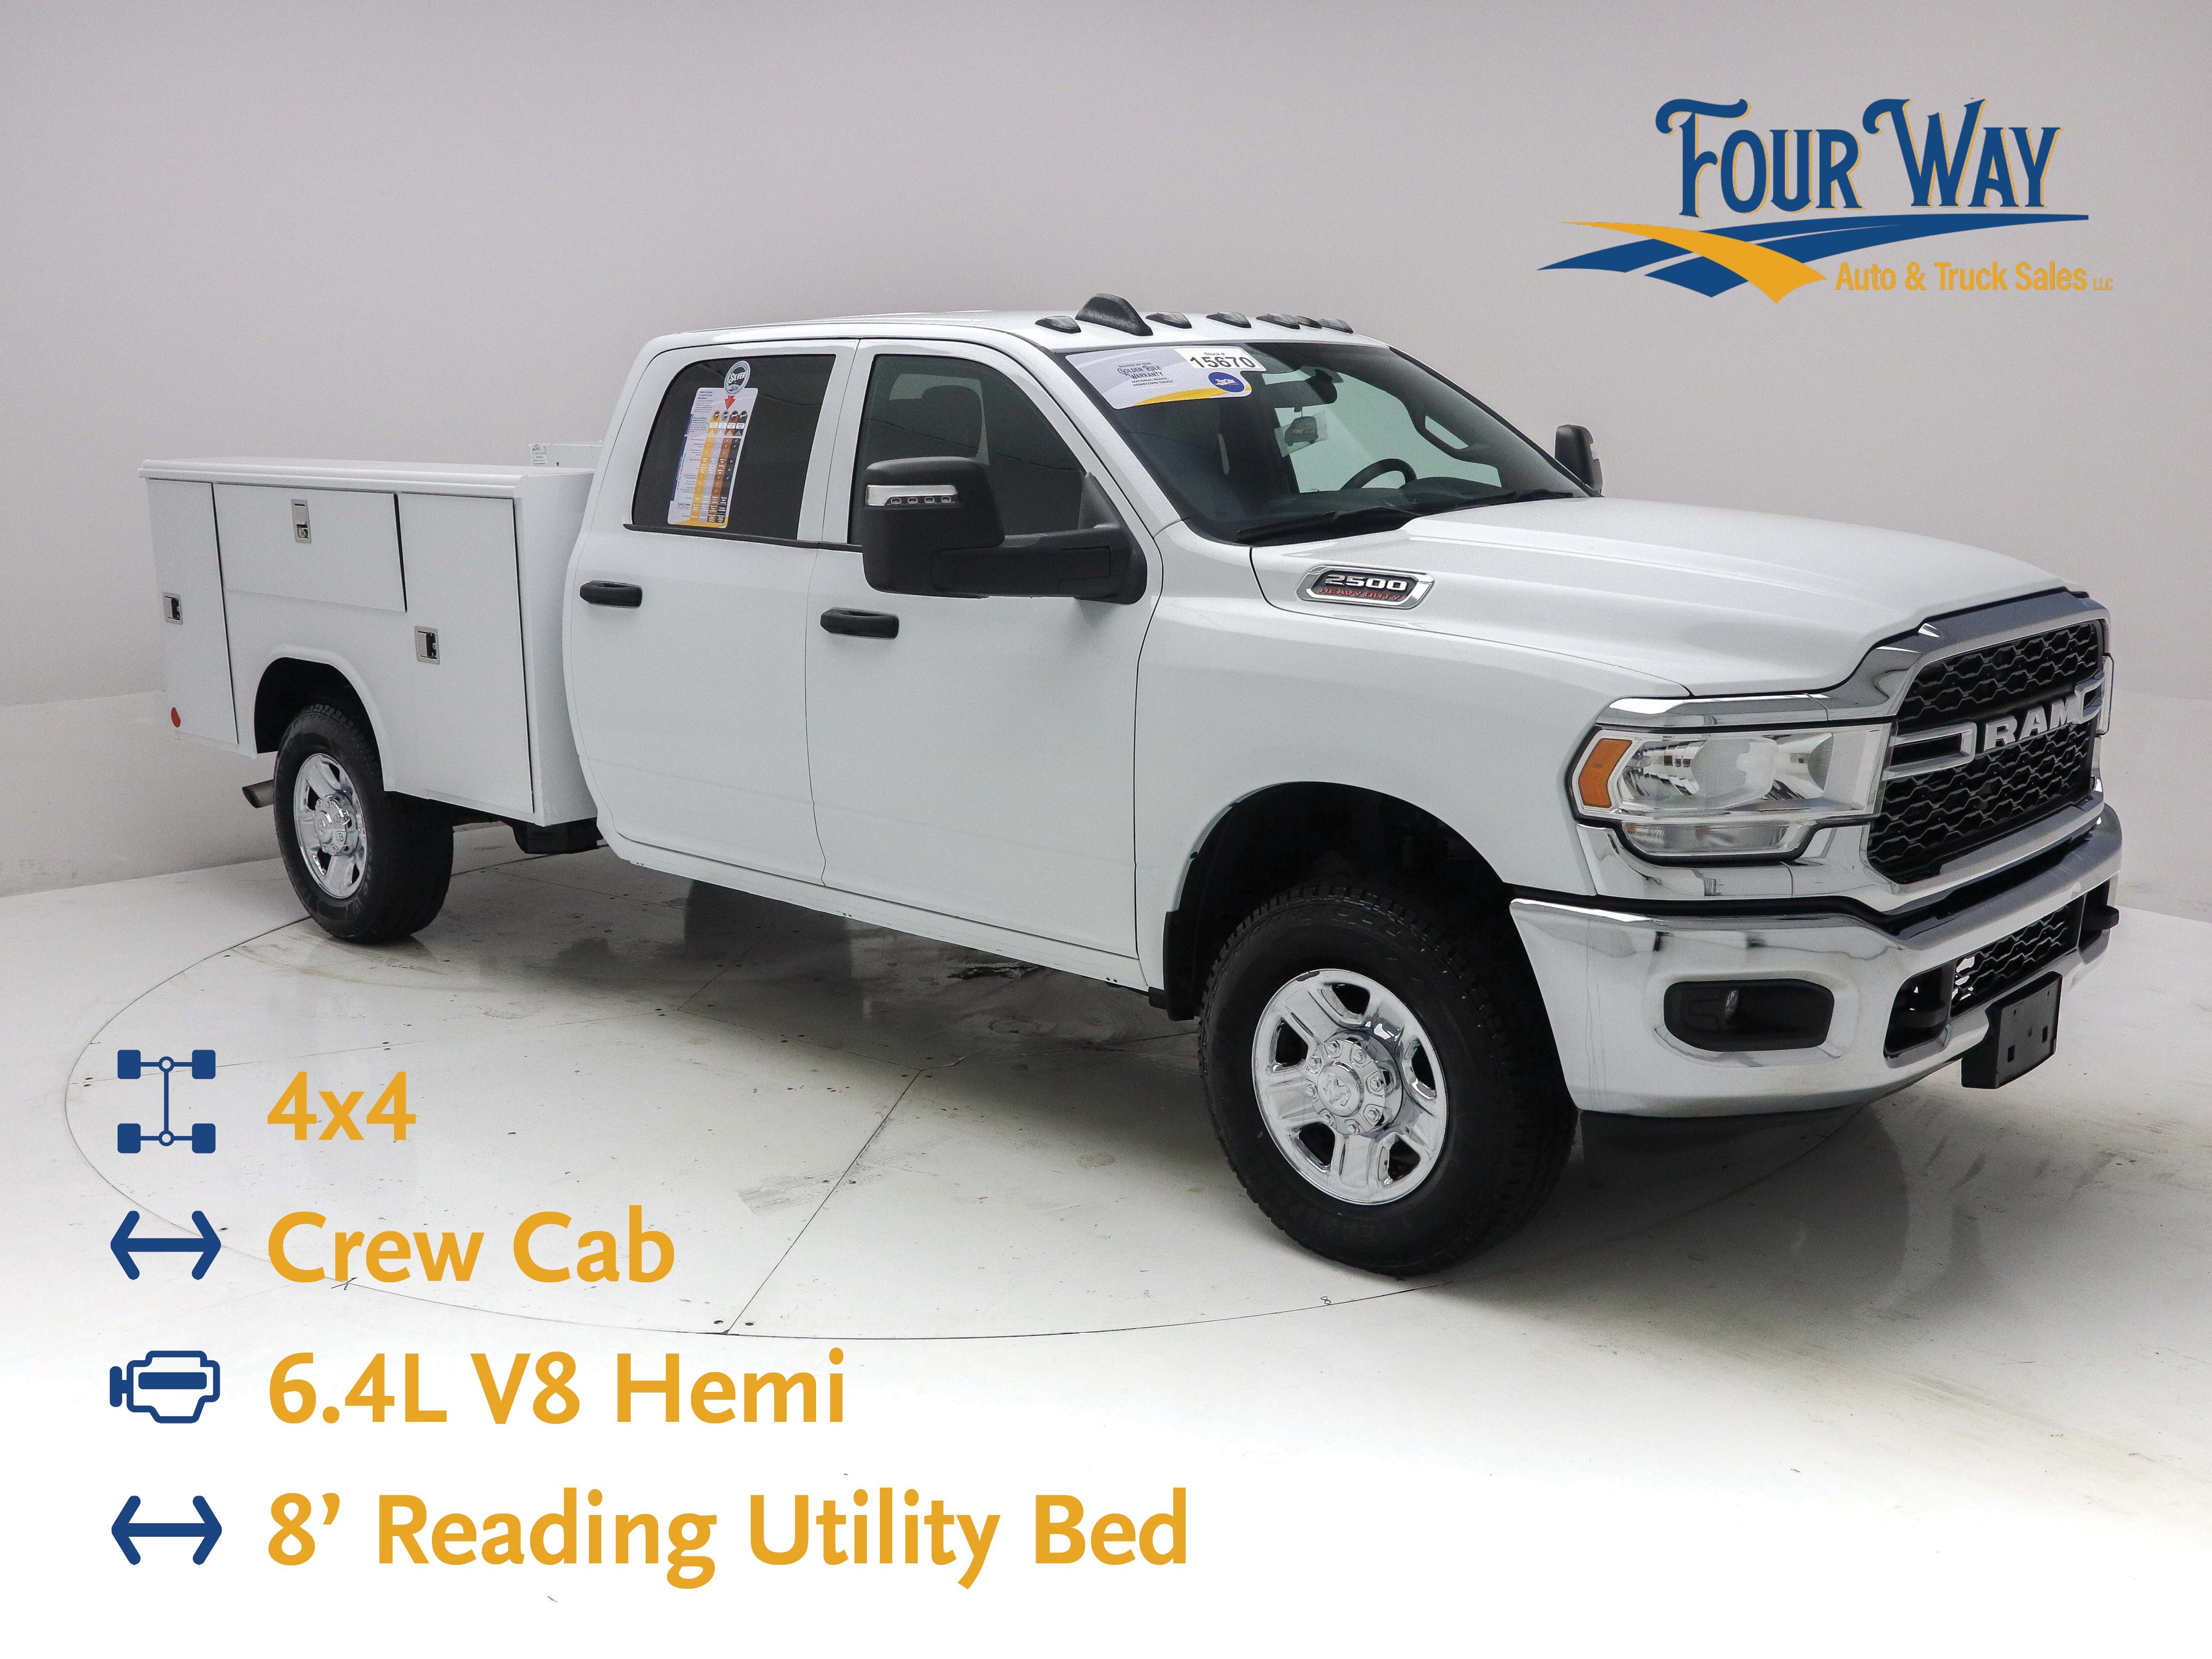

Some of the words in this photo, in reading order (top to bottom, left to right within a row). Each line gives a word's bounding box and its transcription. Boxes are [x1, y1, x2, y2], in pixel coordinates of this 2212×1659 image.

[1190, 357, 1255, 368] 15670
[728, 371, 746, 384] SILVER
[1117, 367, 1143, 376] GOLDEN
[1126, 371, 1163, 380] WARRANTY
[1324, 574, 1408, 591] 2500
[1318, 587, 1364, 596] HEAVY
[1364, 592, 1403, 600] DUTY
[1983, 694, 2079, 751] RAM
